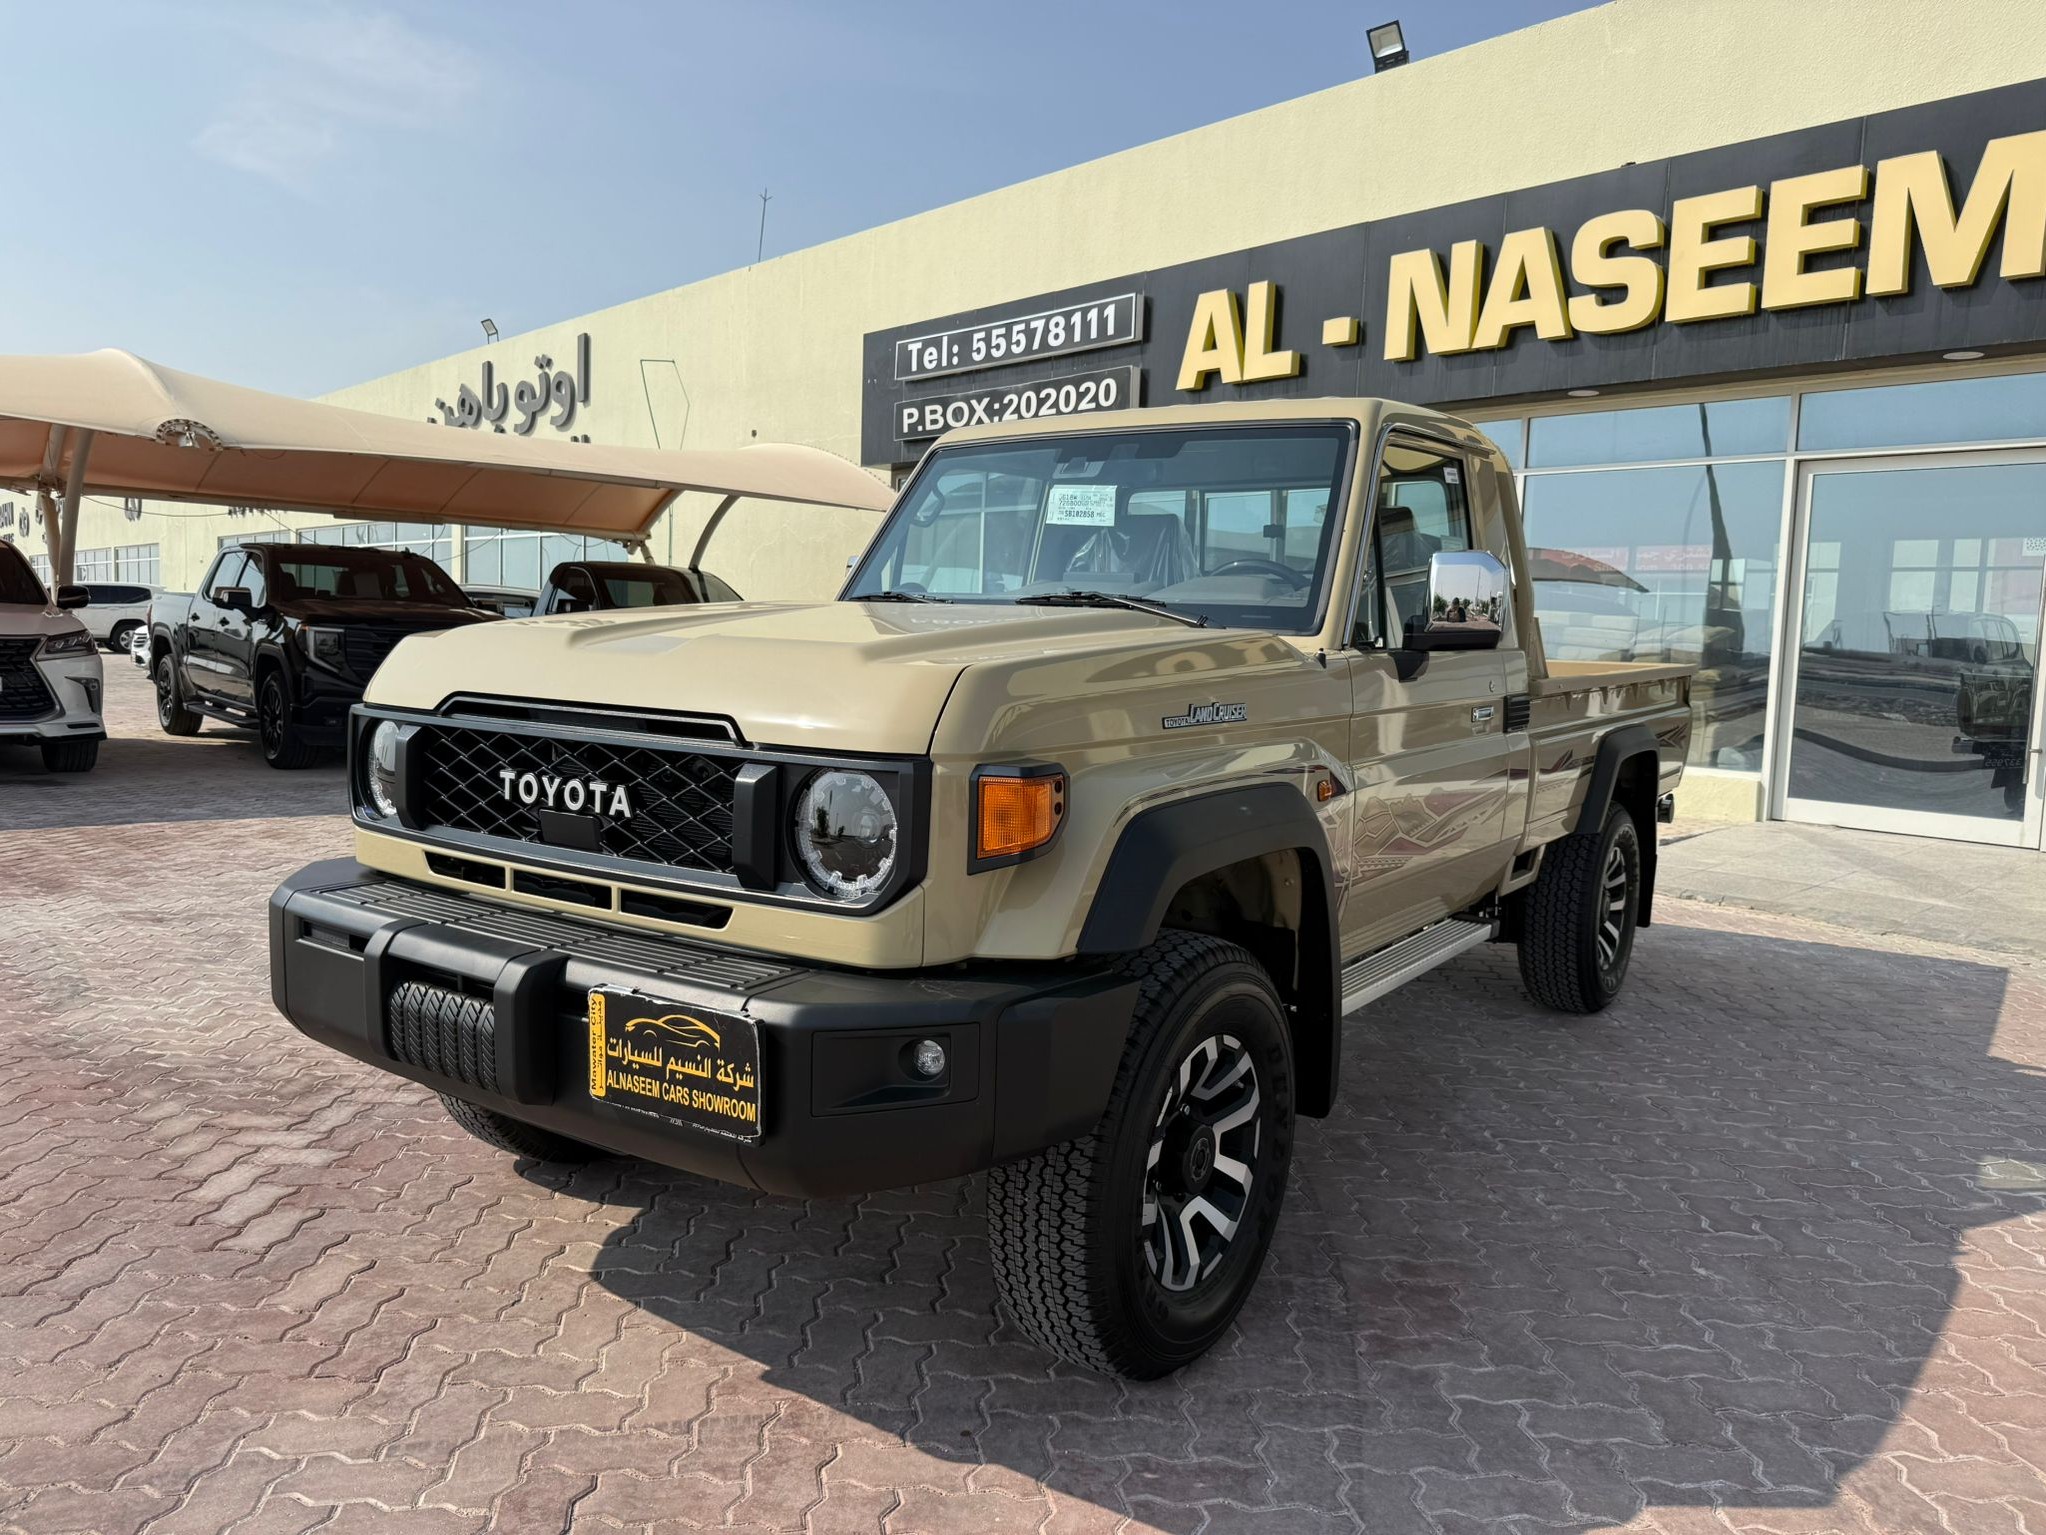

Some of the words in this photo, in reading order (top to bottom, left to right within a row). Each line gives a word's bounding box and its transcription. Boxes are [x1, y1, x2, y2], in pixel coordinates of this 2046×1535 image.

[1176, 279, 1300, 391] AL
[1383, 130, 2046, 362] NASEEM
[907, 336, 959, 372] Tel:
[971, 303, 1116, 362] 55578111
[902, 377, 1118, 434] P.BOX:202020
[1165, 716, 1190, 728] TOYOTA
[1189, 704, 1213, 722] LAND
[1212, 702, 1247, 720] CRUISER
[499, 769, 632, 818] TOYOTA
[590, 998, 598, 1026] City
[607, 1037, 662, 1070] للسيارات
[666, 1054, 712, 1081] النسيم
[607, 1069, 660, 1099] ALNASEEM
[662, 1082, 690, 1108] CARS
[692, 1089, 756, 1122] SHOWROOM
[716, 1058, 755, 1092] شركة
